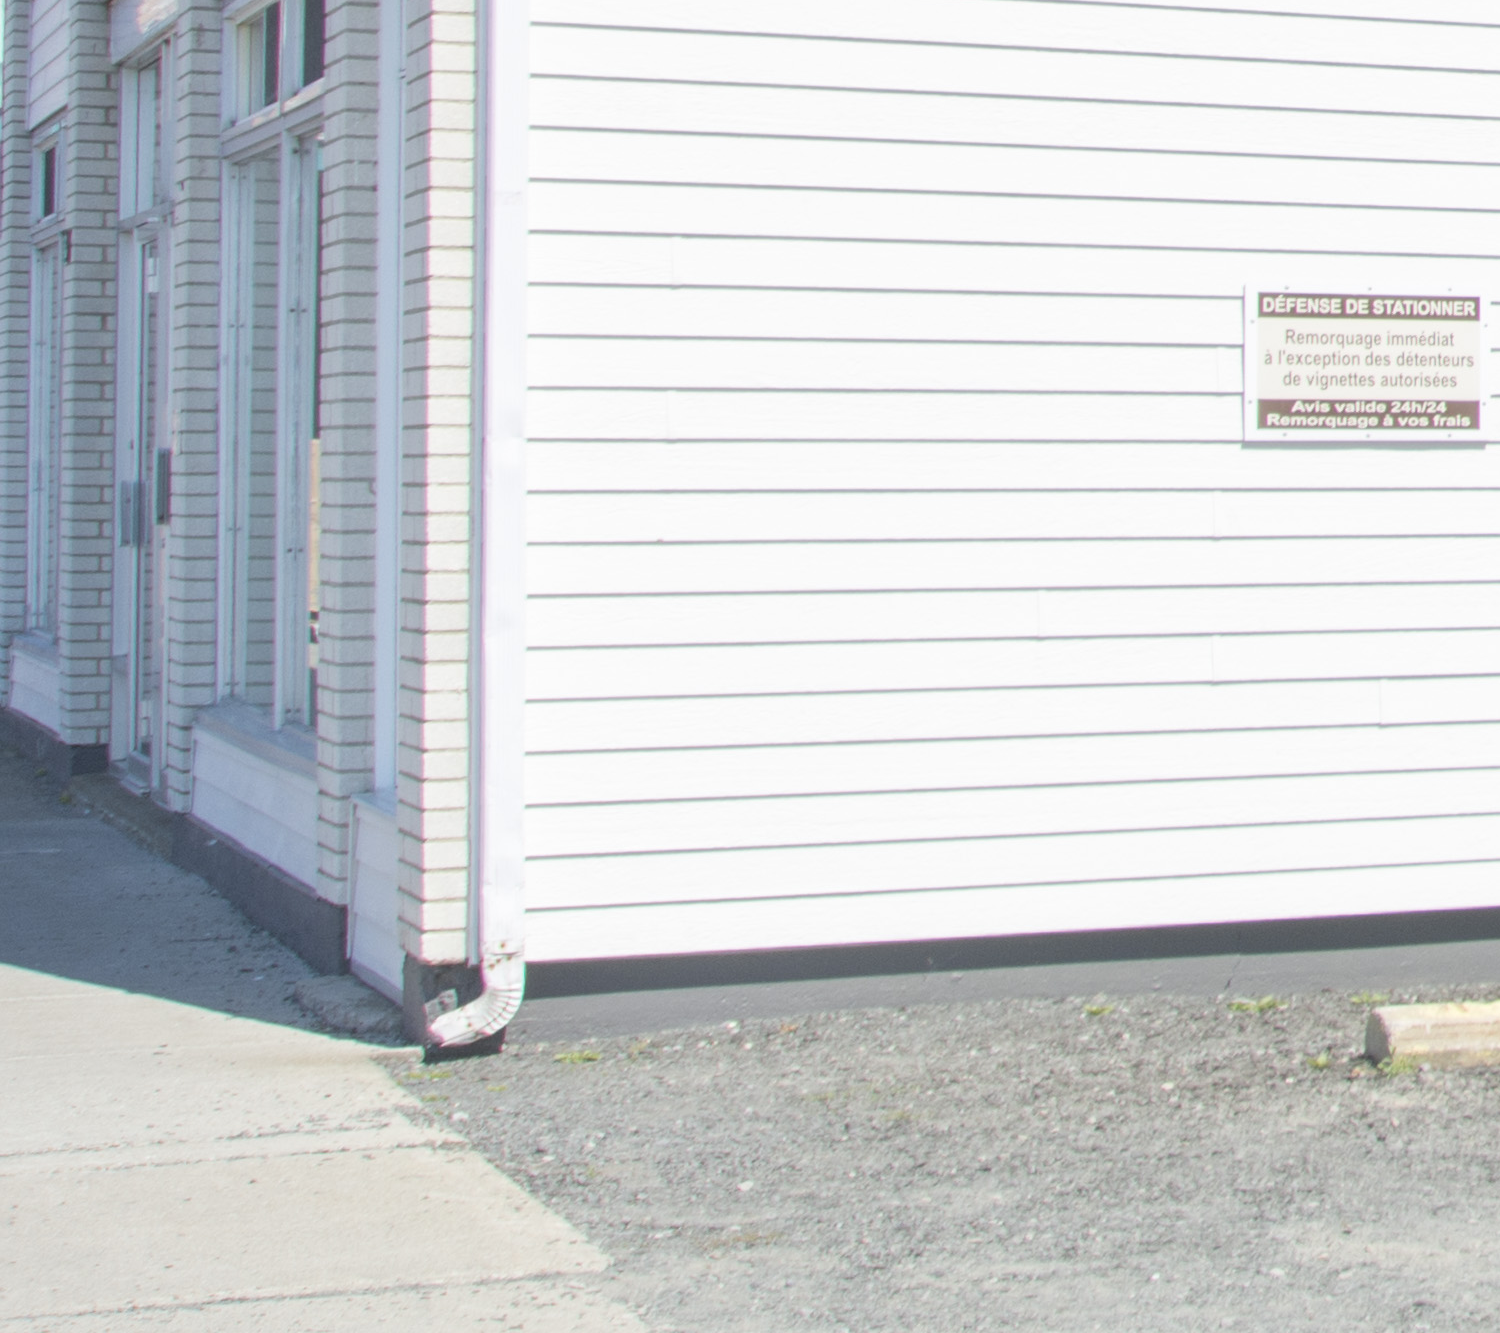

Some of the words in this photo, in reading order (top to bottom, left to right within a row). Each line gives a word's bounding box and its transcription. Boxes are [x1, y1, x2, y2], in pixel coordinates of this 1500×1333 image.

[1262, 295, 1341, 314] DÉFENSE
[1346, 298, 1369, 314] DE
[1373, 299, 1475, 317] STATIONNER
[1285, 329, 1382, 349] Remorquage
[1387, 331, 1454, 347] immédiat
[1264, 349, 1272, 365] à
[1278, 350, 1360, 369] l'exception
[1365, 351, 1391, 366] des
[1397, 352, 1474, 367] détenteurs
[1283, 371, 1300, 386] de
[1306, 372, 1375, 390] vignettes
[1380, 373, 1457, 388] autorisées
[1291, 400, 1330, 413] Avis
[1334, 401, 1386, 413] valide
[1391, 401, 1447, 414] 24h/24
[1266, 413, 1378, 428] Remorquage
[1383, 414, 1393, 426] à
[1398, 417, 1428, 427] vos
[1433, 415, 1471, 427] frais
